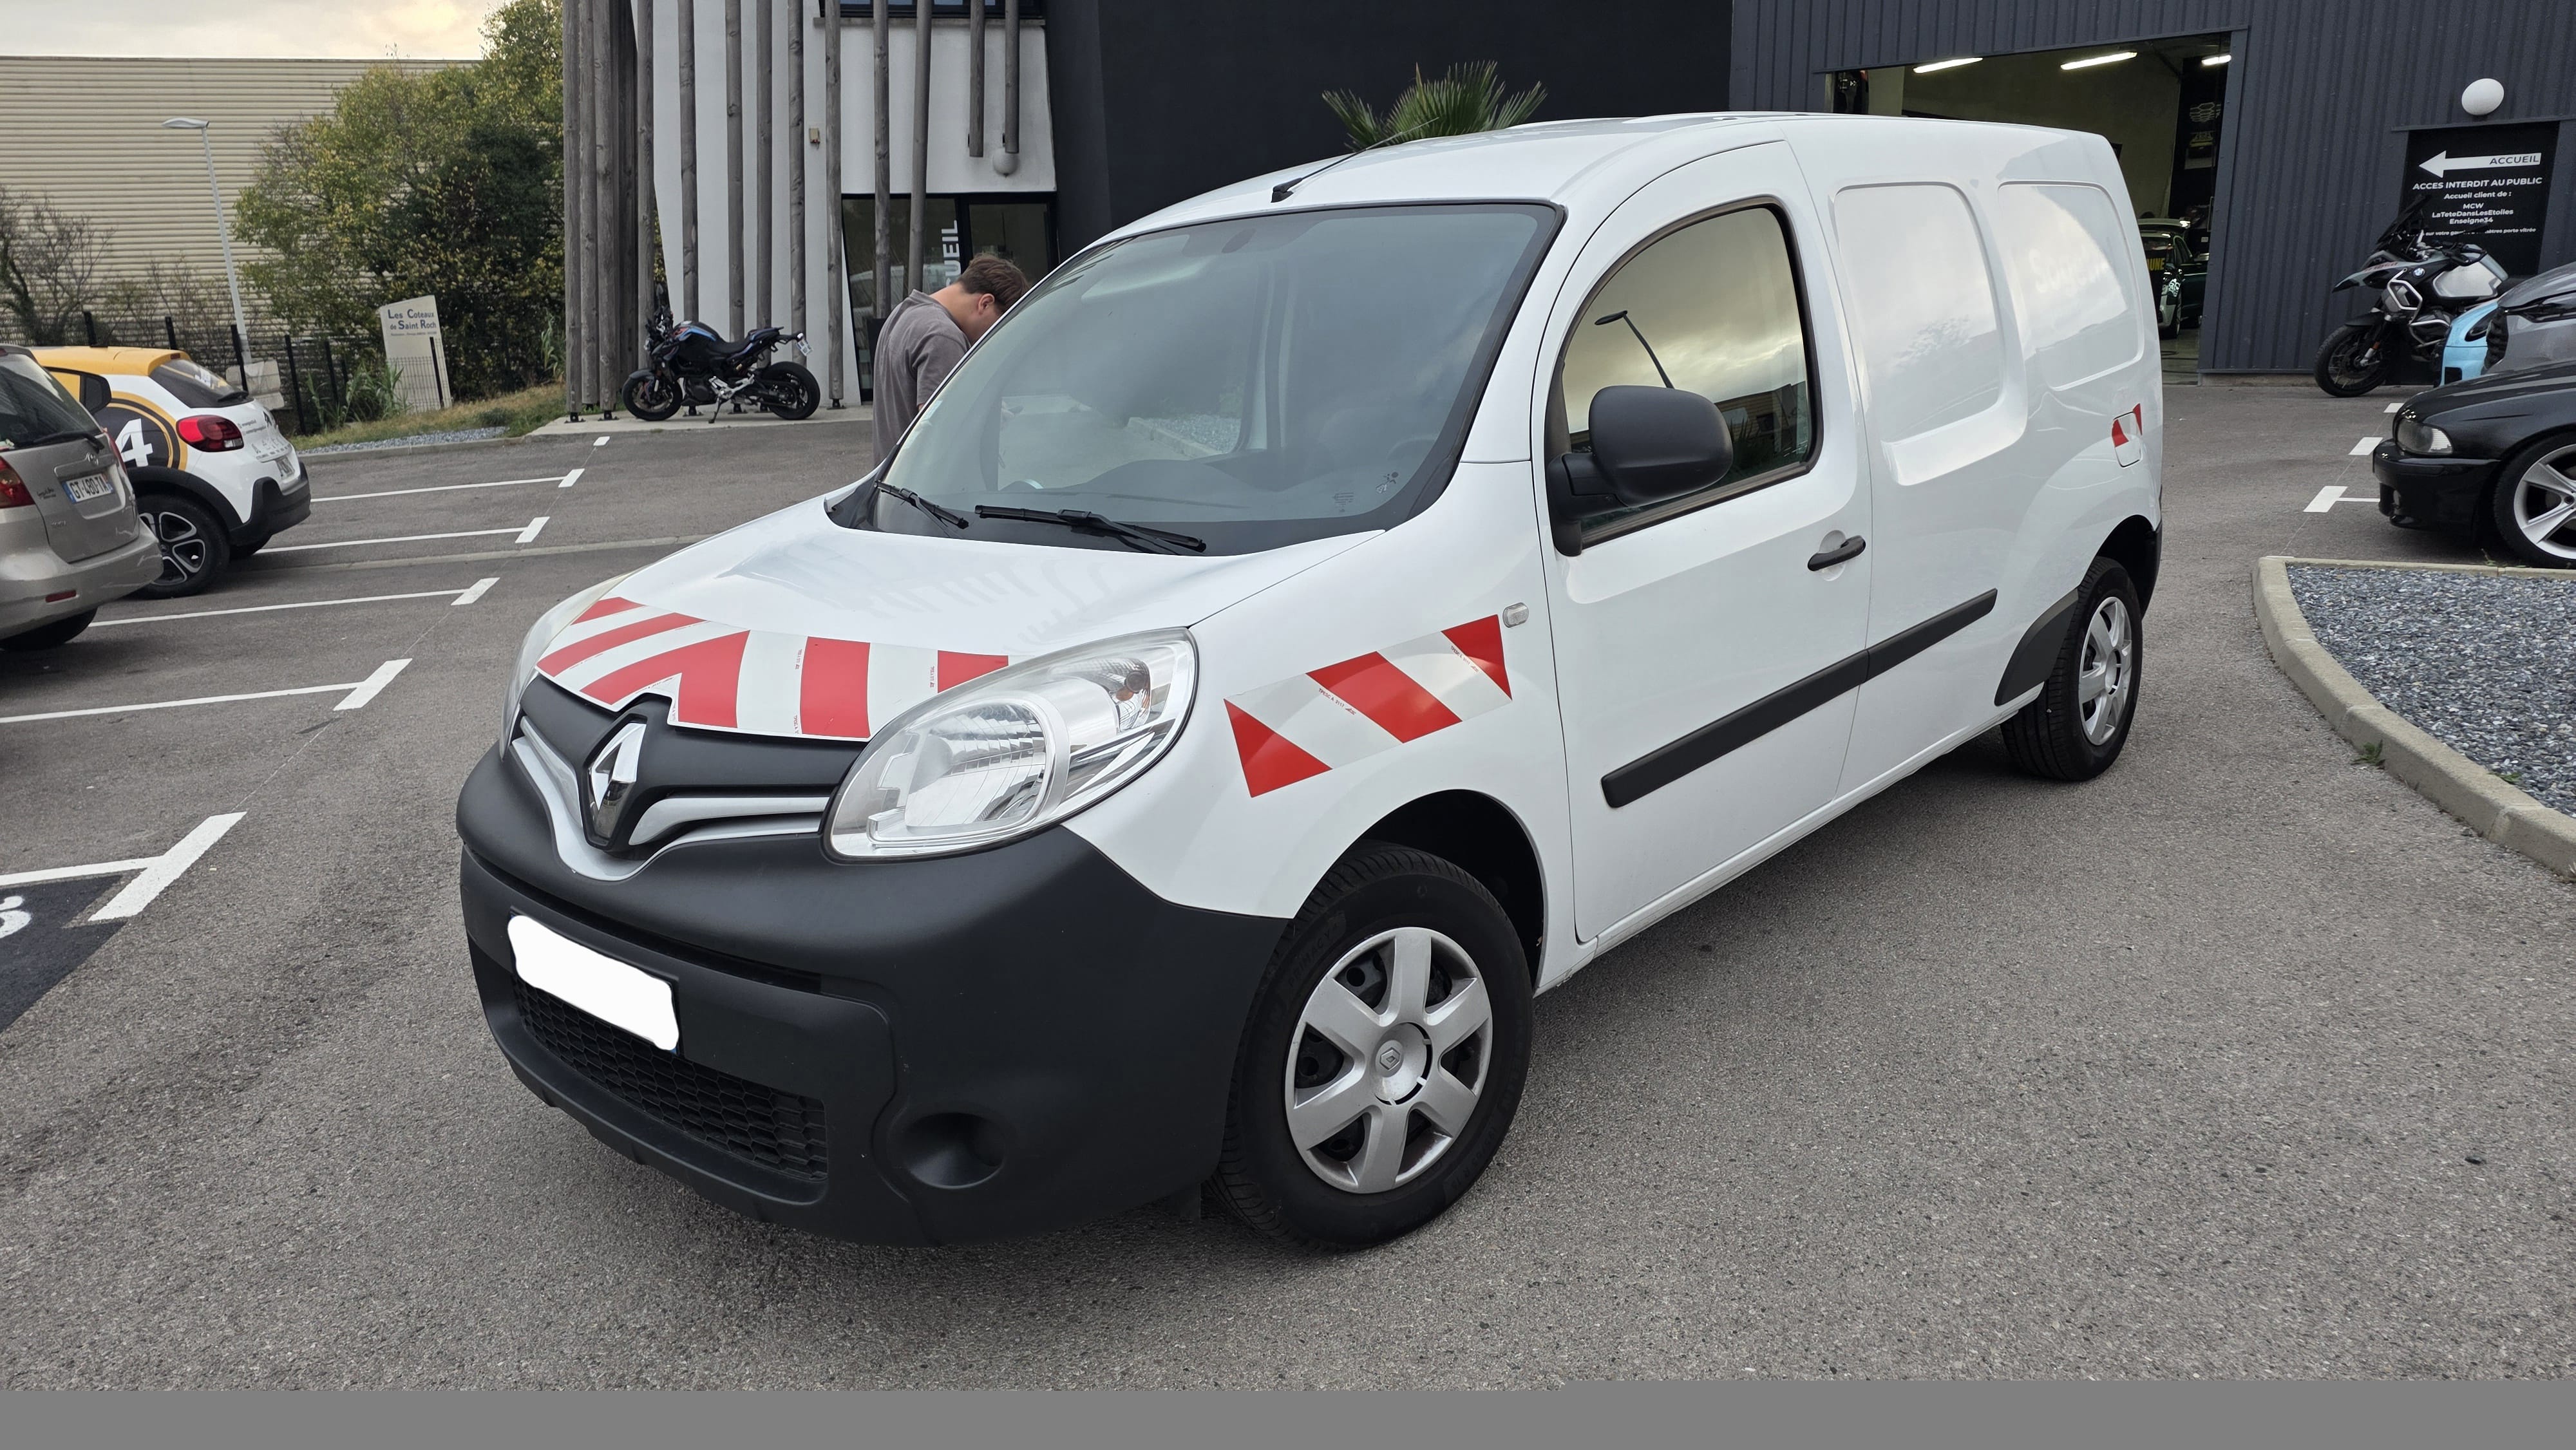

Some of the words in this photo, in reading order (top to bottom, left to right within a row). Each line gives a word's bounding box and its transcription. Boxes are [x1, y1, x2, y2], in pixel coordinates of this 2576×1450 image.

[2490, 155, 2539, 165] ACCUEIL
[2445, 180, 2490, 189] INTERDIT
[2506, 177, 2543, 186] PUBLIC
[388, 308, 403, 319] Les
[407, 308, 435, 319] Coteaux
[397, 320, 419, 330] Saint
[420, 319, 437, 329] Roch
